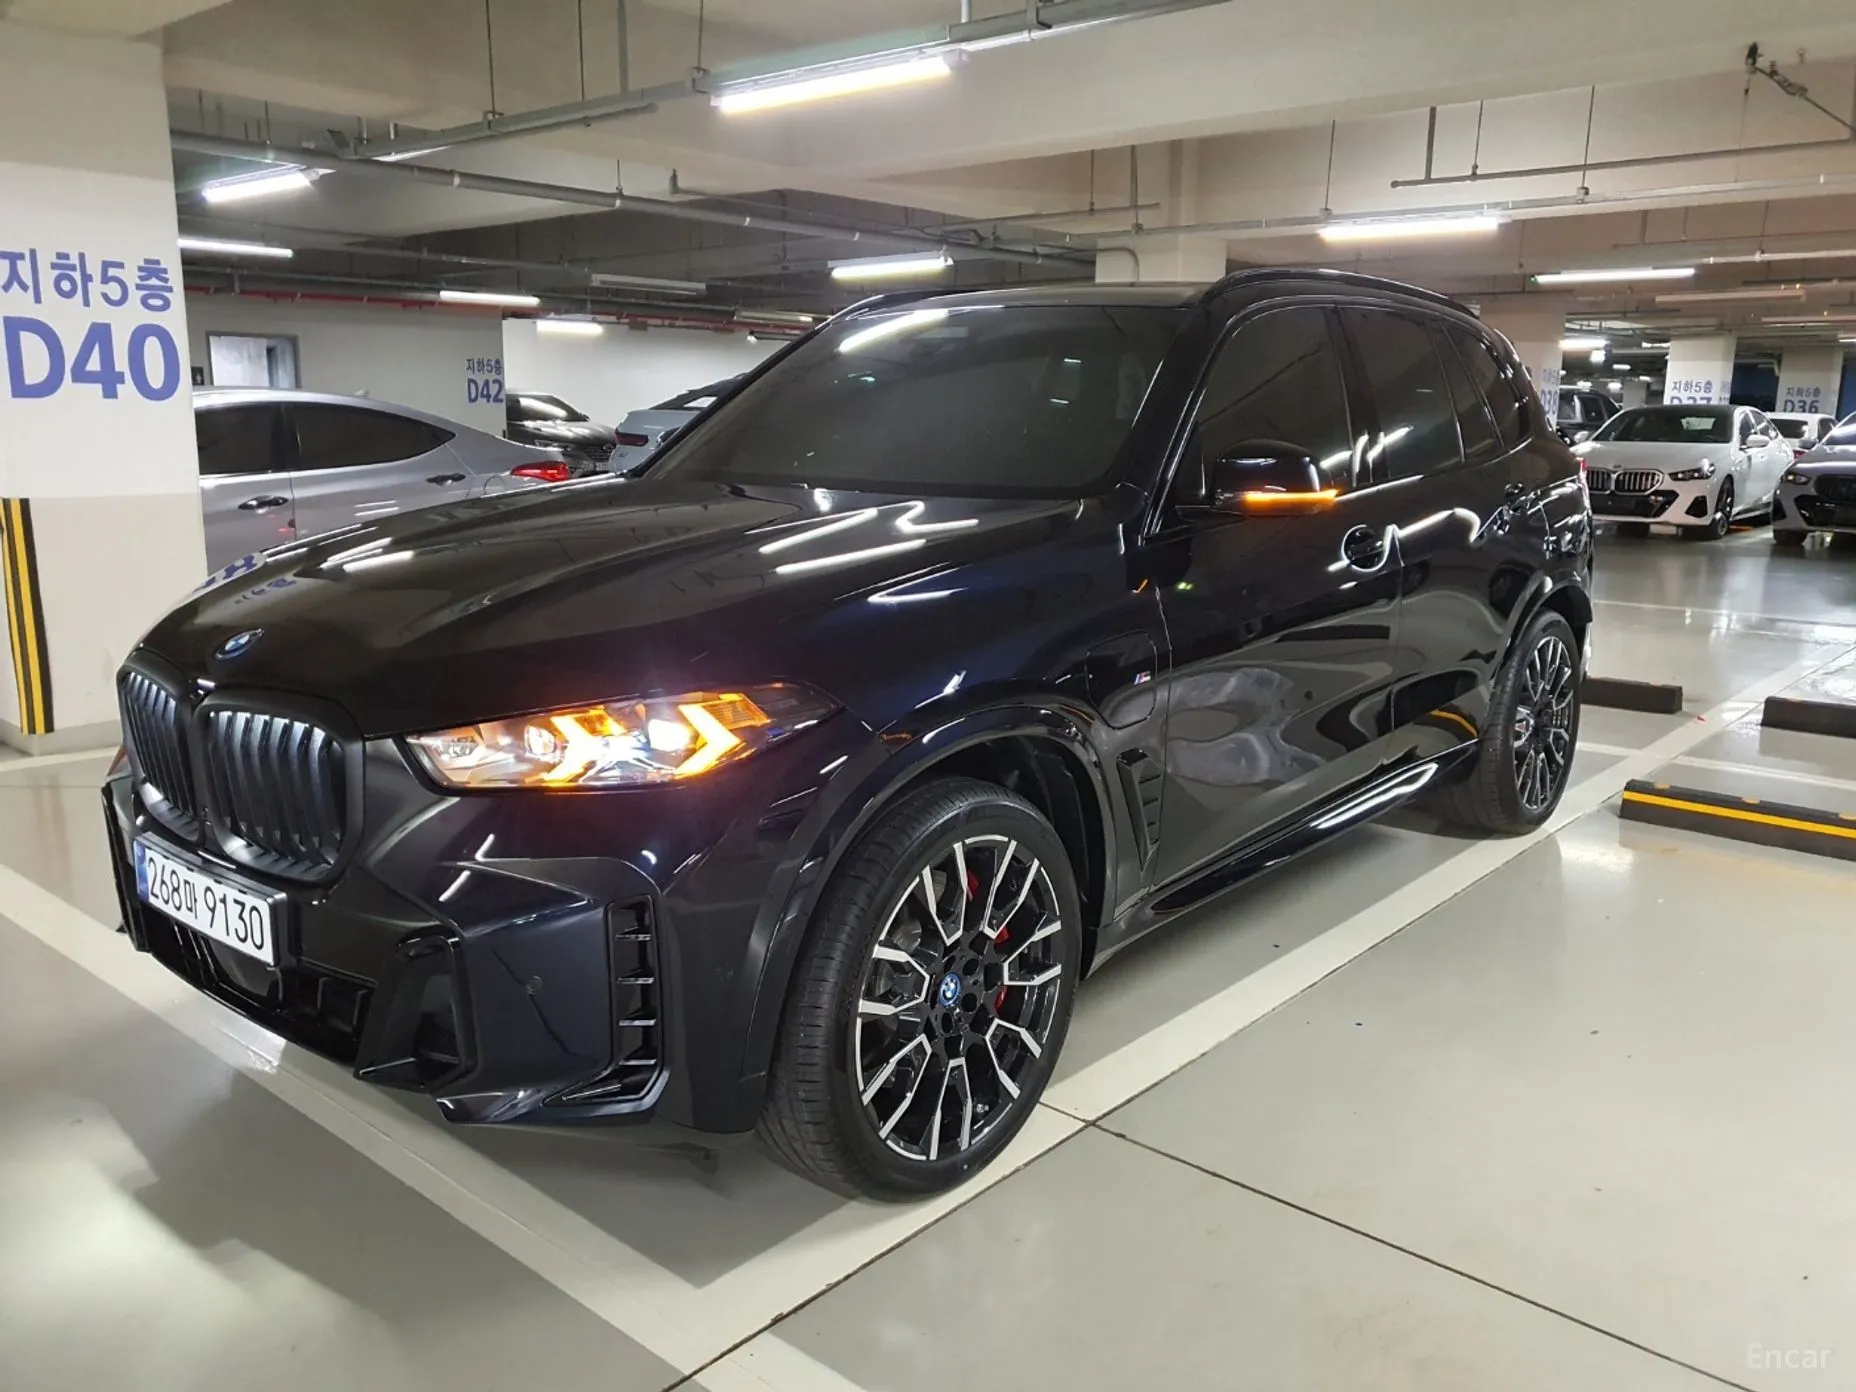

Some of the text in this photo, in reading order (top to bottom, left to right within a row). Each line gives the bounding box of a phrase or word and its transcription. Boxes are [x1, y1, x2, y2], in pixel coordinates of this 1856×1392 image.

[0, 248, 174, 312] 지하5층
[3, 316, 181, 402] D40
[467, 378, 504, 403] D42
[148, 857, 264, 950] 268마 9130
